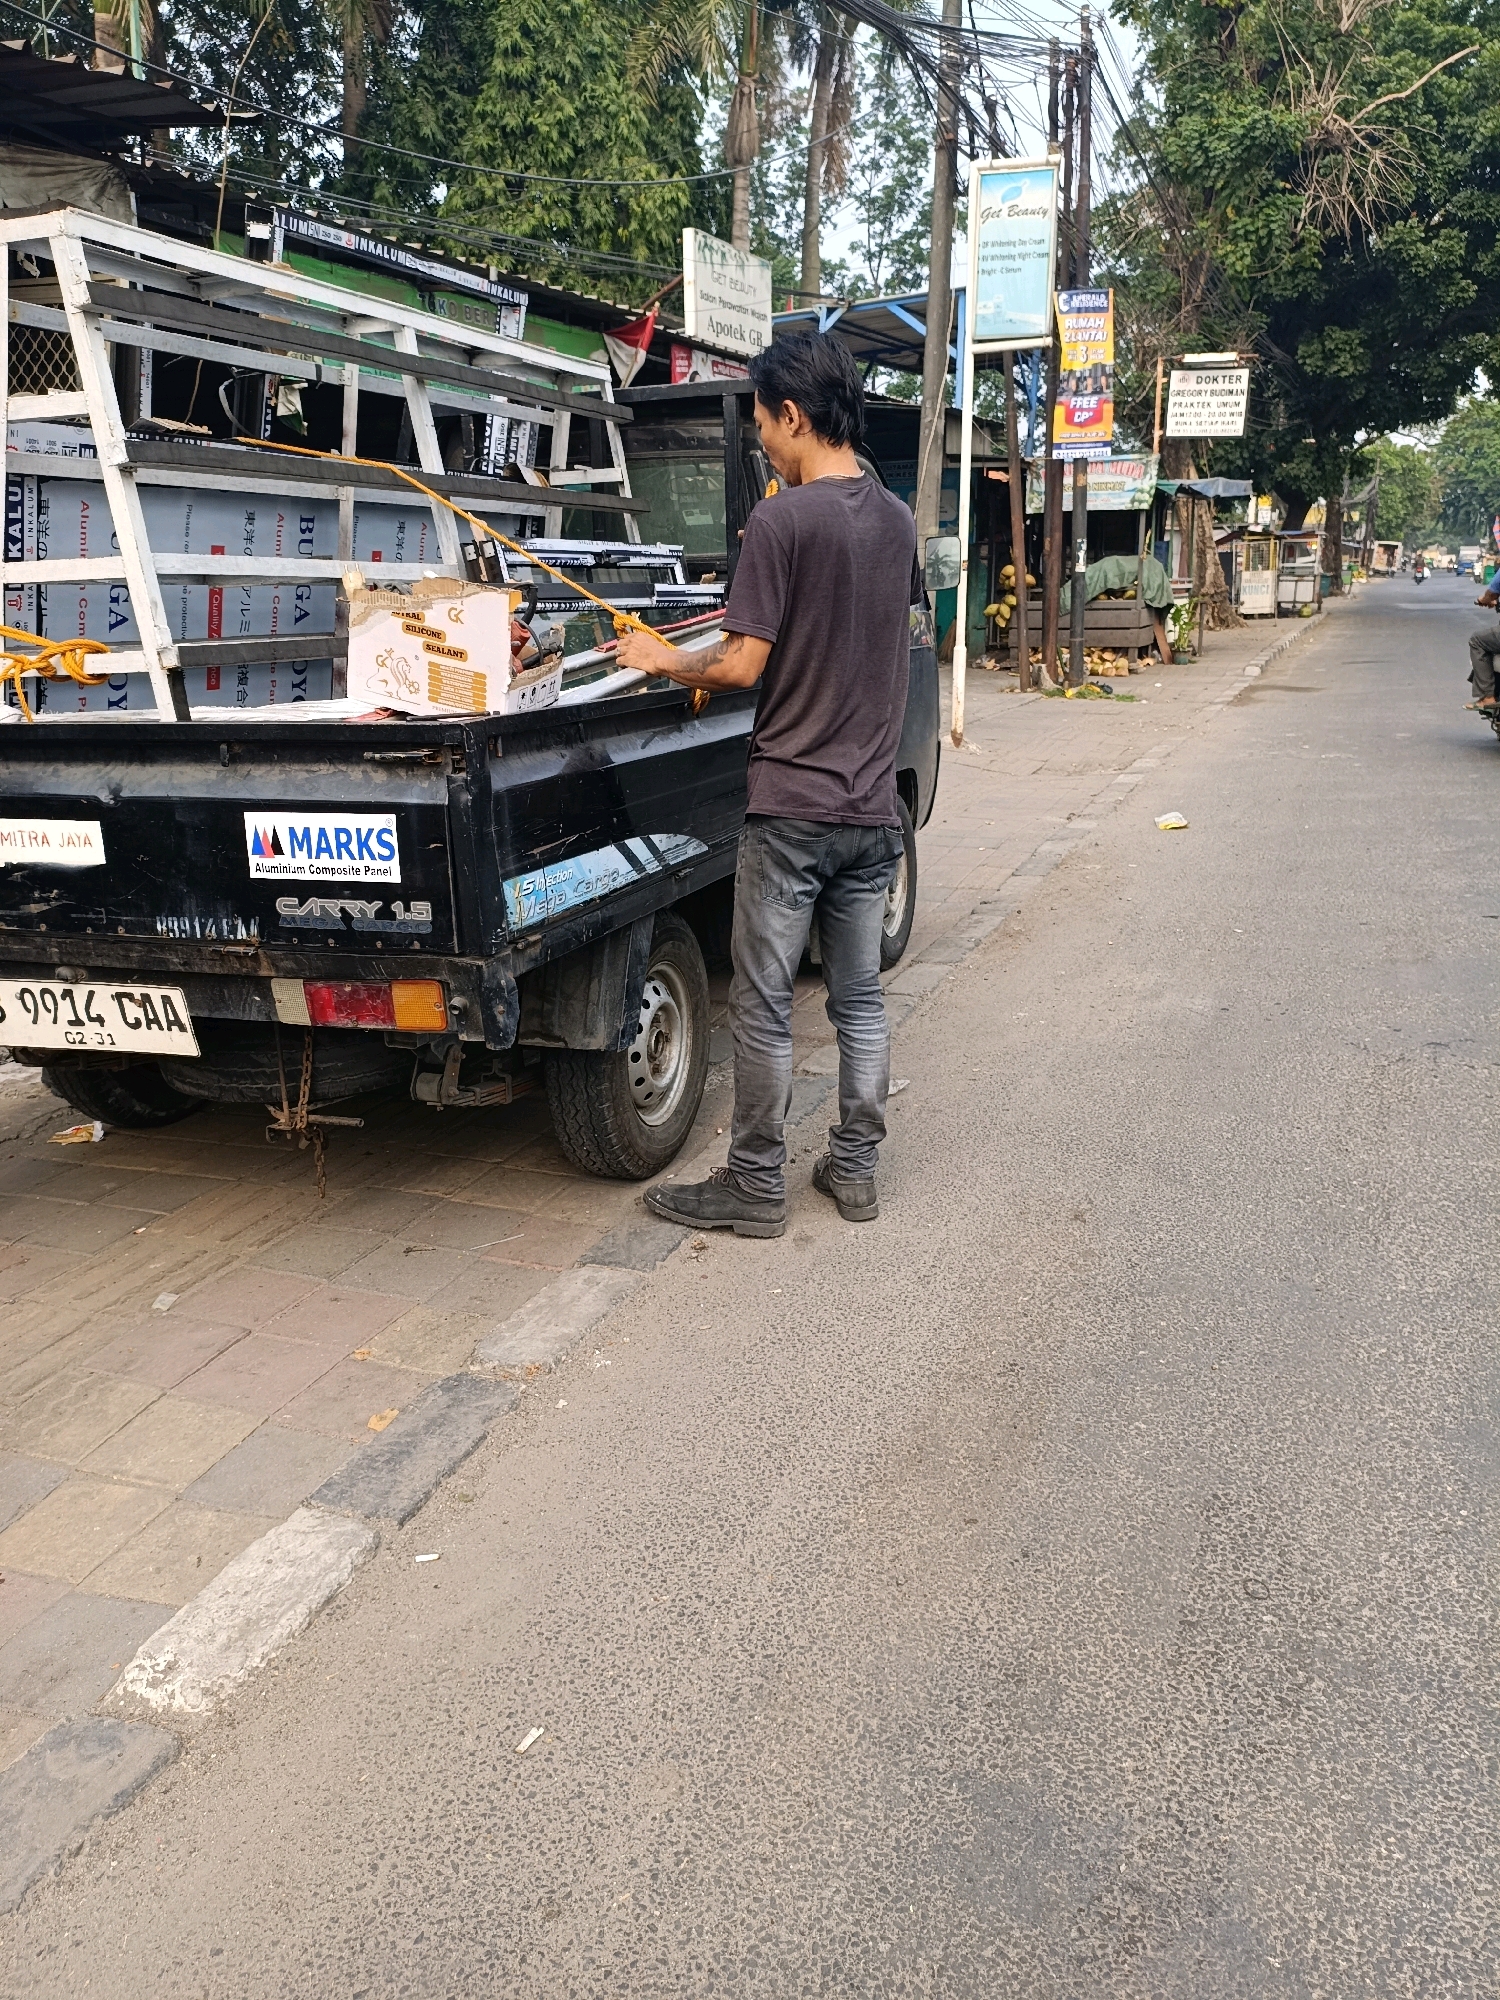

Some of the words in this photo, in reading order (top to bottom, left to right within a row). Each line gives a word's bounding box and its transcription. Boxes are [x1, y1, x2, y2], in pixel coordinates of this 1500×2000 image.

[981, 206, 1002, 225] Get
[1006, 204, 1049, 219] Beauty
[354, 233, 408, 266] INKALUM
[1028, 237, 1045, 246] Cream
[1017, 251, 1031, 261] Night
[981, 267, 997, 277] Bright
[1005, 267, 1022, 275] Serum
[711, 270, 727, 287] GET
[729, 276, 758, 299] BEAUTY
[699, 289, 717, 304] Salon
[717, 296, 750, 316] Perawatan
[750, 308, 768, 323] Wajah
[1071, 300, 1109, 308] RESIDENCE
[707, 314, 746, 343] Apotek
[748, 328, 763, 347] GB
[1065, 317, 1105, 330] RUMAH
[1080, 345, 1088, 364] 3
[1196, 374, 1242, 385] DOKTER
[1170, 388, 1209, 398] GREGORY
[1209, 388, 1246, 397] BUDIMAN
[1069, 396, 1099, 409] FREE
[1172, 400, 1212, 409] PRAKTEK
[1216, 400, 1241, 409] UMUM
[1092, 481, 1127, 492] NIKMAT
[1242, 584, 1270, 596] KUNCI
[210, 594, 221, 630] Quality
[447, 606, 465, 625] GK
[405, 624, 442, 640] SILICONE
[425, 643, 465, 659] SEALANT
[375, 654, 389, 669] GK
[1, 829, 51, 848] MITRA
[58, 832, 94, 849] JAYA
[288, 826, 396, 862] MARKS
[255, 862, 306, 876] Aluminium
[308, 863, 361, 877] Composite
[364, 865, 393, 877] Panel
[514, 879, 536, 900] 1.5
[535, 869, 574, 891] Injection
[514, 889, 568, 925] Mega
[573, 867, 620, 898] Cargo
[276, 897, 383, 919] CARRY
[391, 901, 433, 921] 1.5
[279, 916, 348, 931] MEGA
[351, 919, 433, 934] CARGO
[19, 986, 106, 1028] 9914
[111, 990, 189, 1034] CAA
